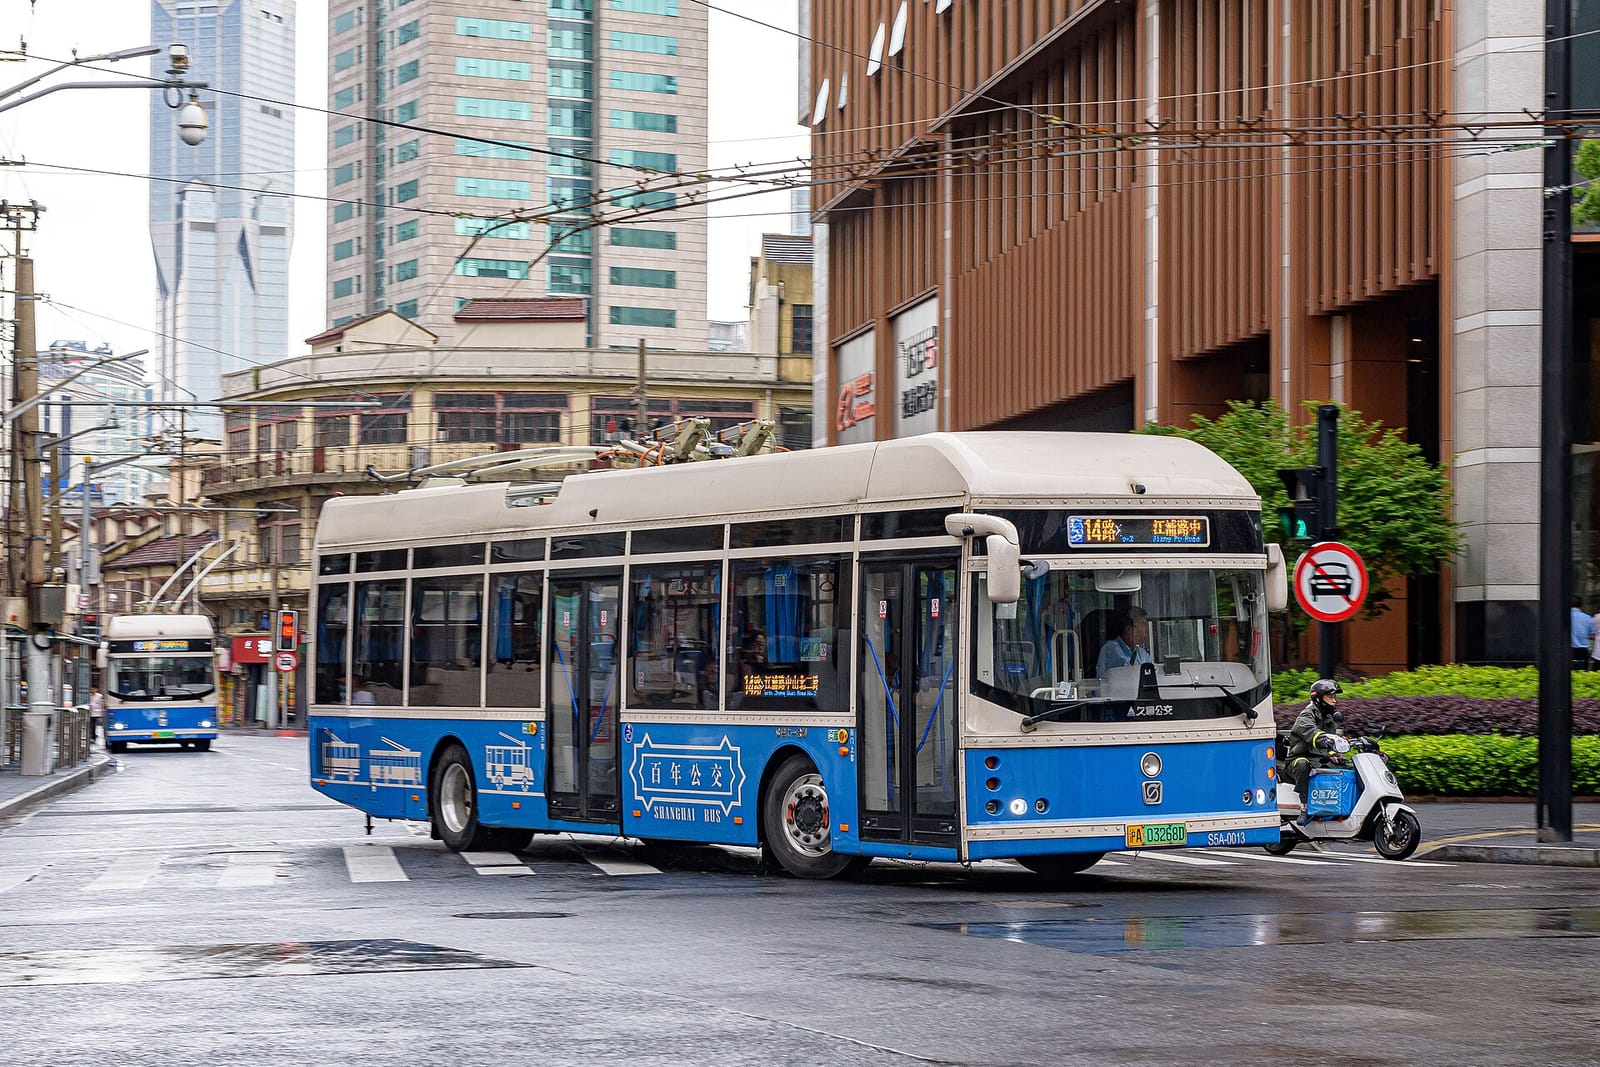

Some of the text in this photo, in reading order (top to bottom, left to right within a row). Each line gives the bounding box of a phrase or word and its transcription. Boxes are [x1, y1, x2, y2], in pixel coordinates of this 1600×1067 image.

[1084, 518, 1115, 542] 14路
[650, 761, 722, 788] 百年公交
[654, 806, 721, 823] SHANGHAI BUS
[1208, 832, 1246, 846] S5A-0013
